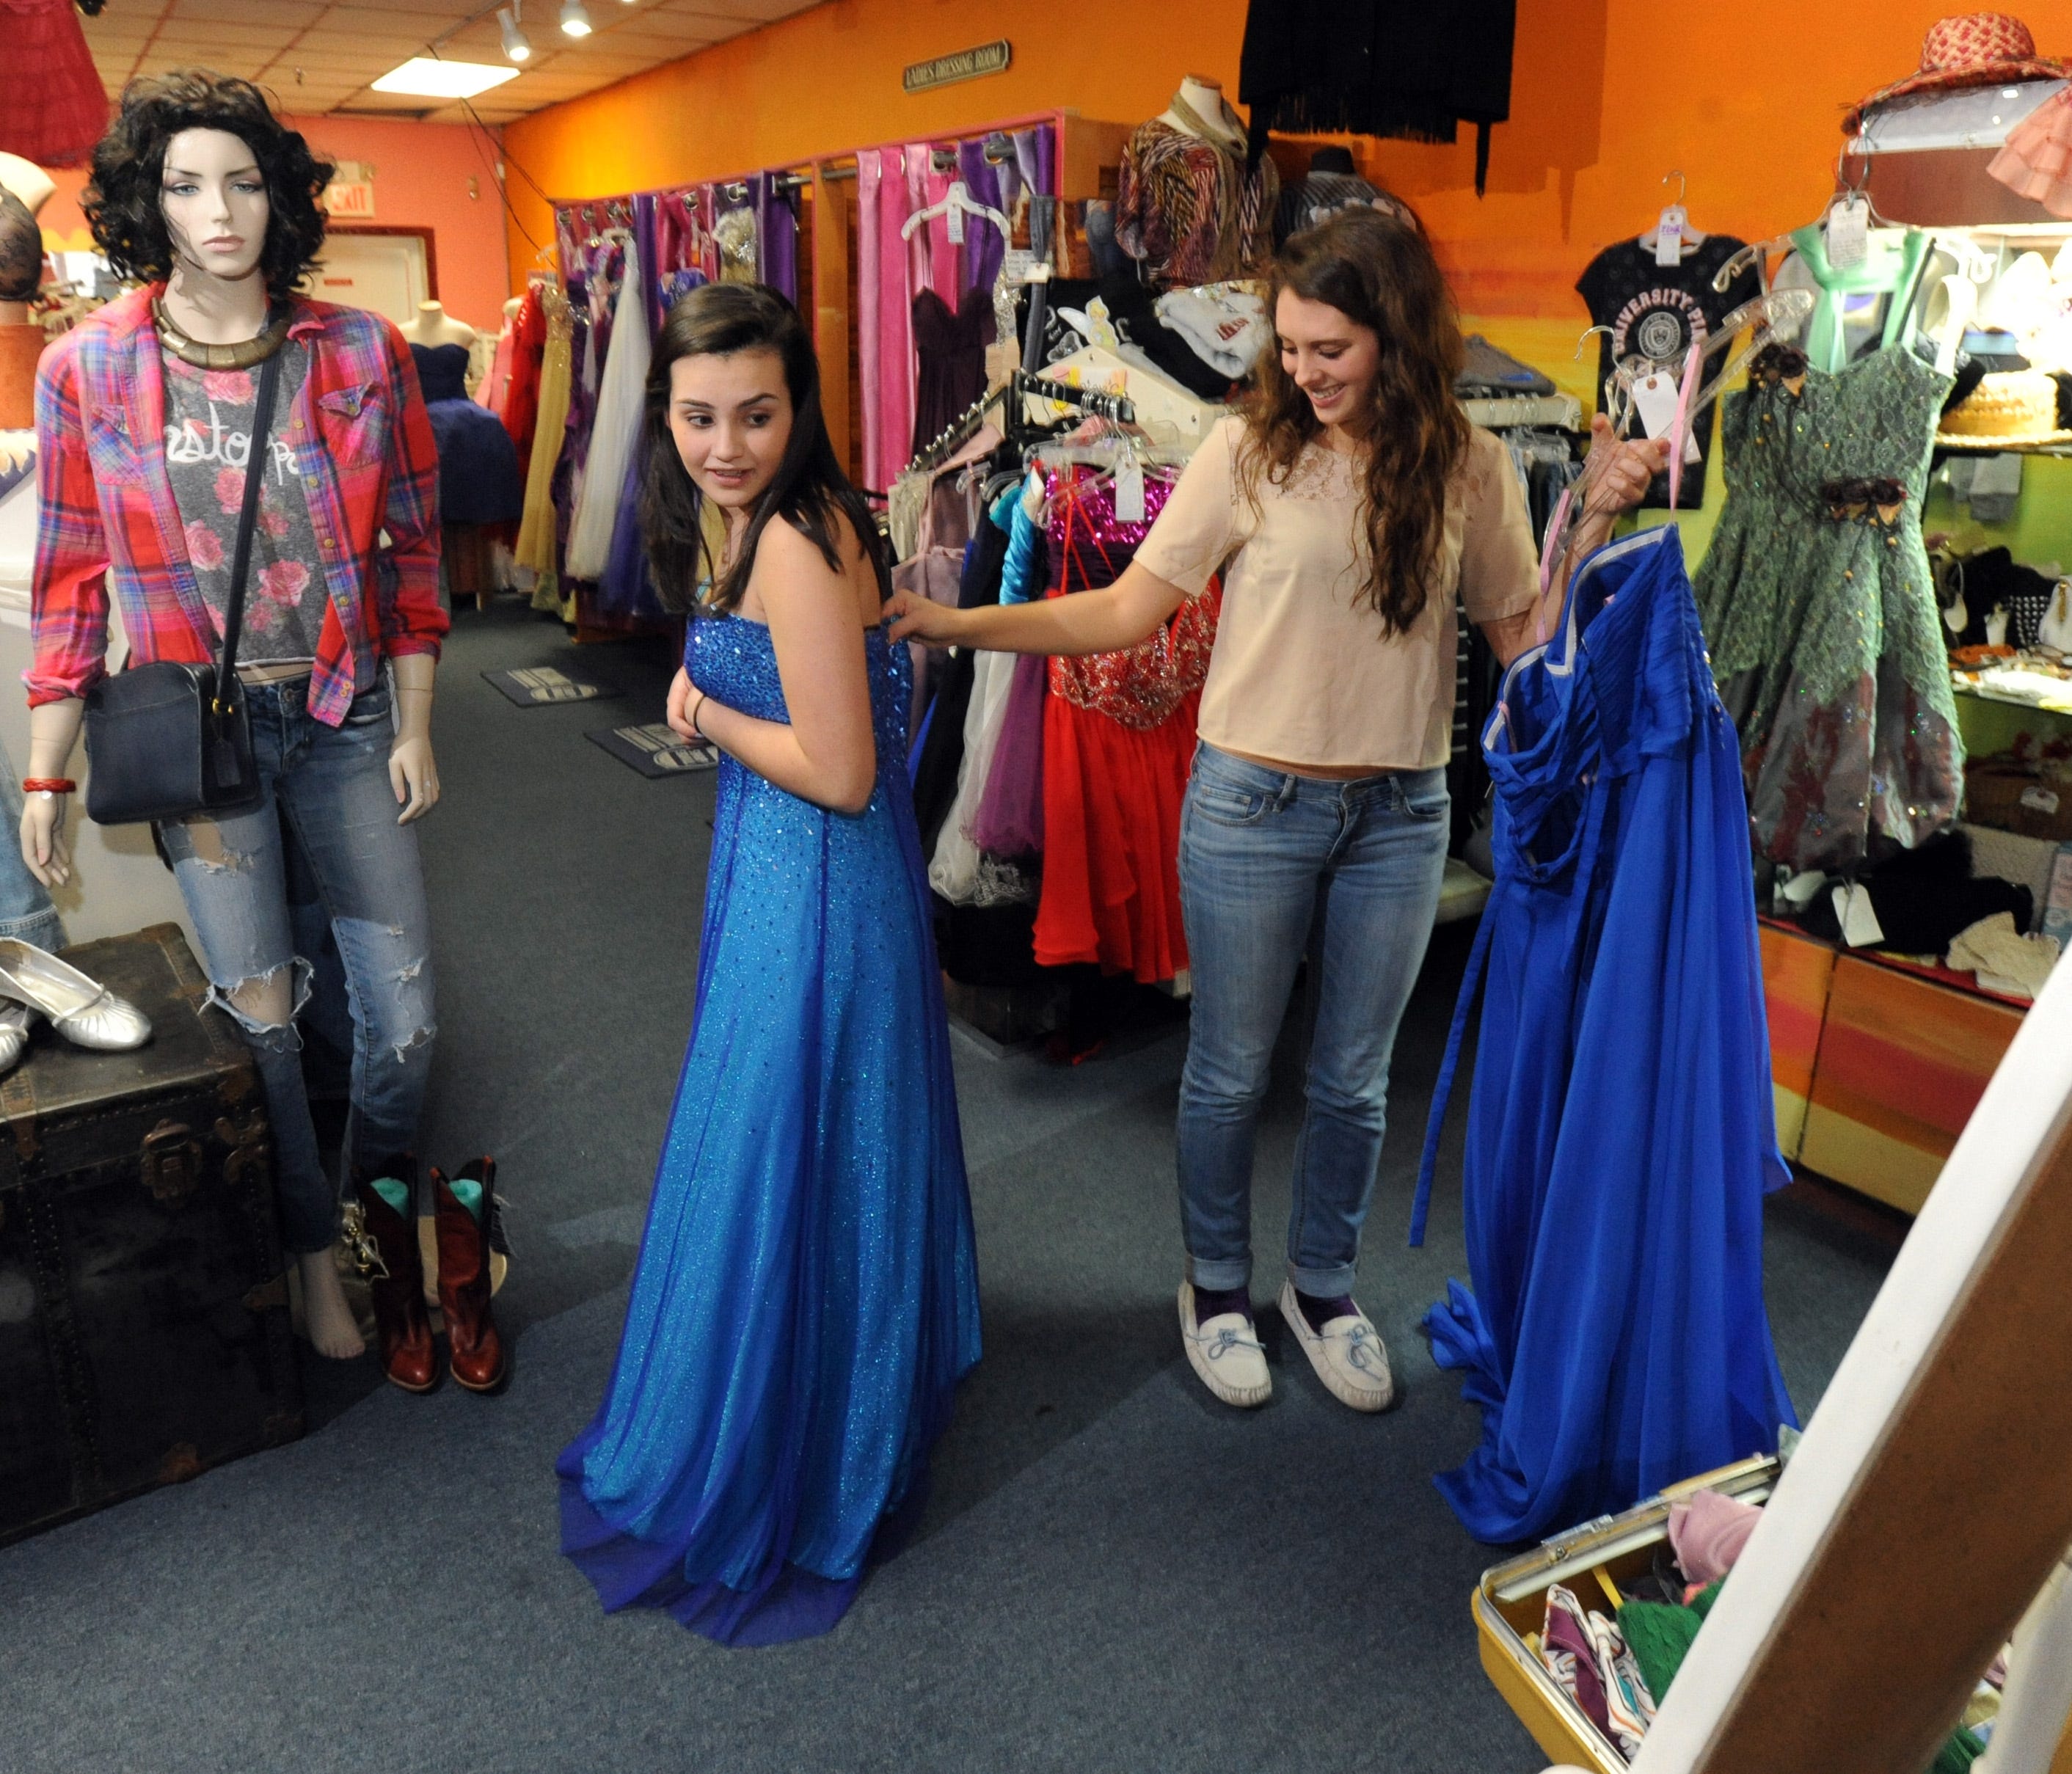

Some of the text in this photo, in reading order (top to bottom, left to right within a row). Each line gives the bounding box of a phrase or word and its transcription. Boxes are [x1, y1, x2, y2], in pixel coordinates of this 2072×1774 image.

[906, 45, 1001, 87] LADIES DRESSING ROOM
[332, 186, 367, 211] EXIT
[1613, 288, 1694, 354] UNIVERSITY
